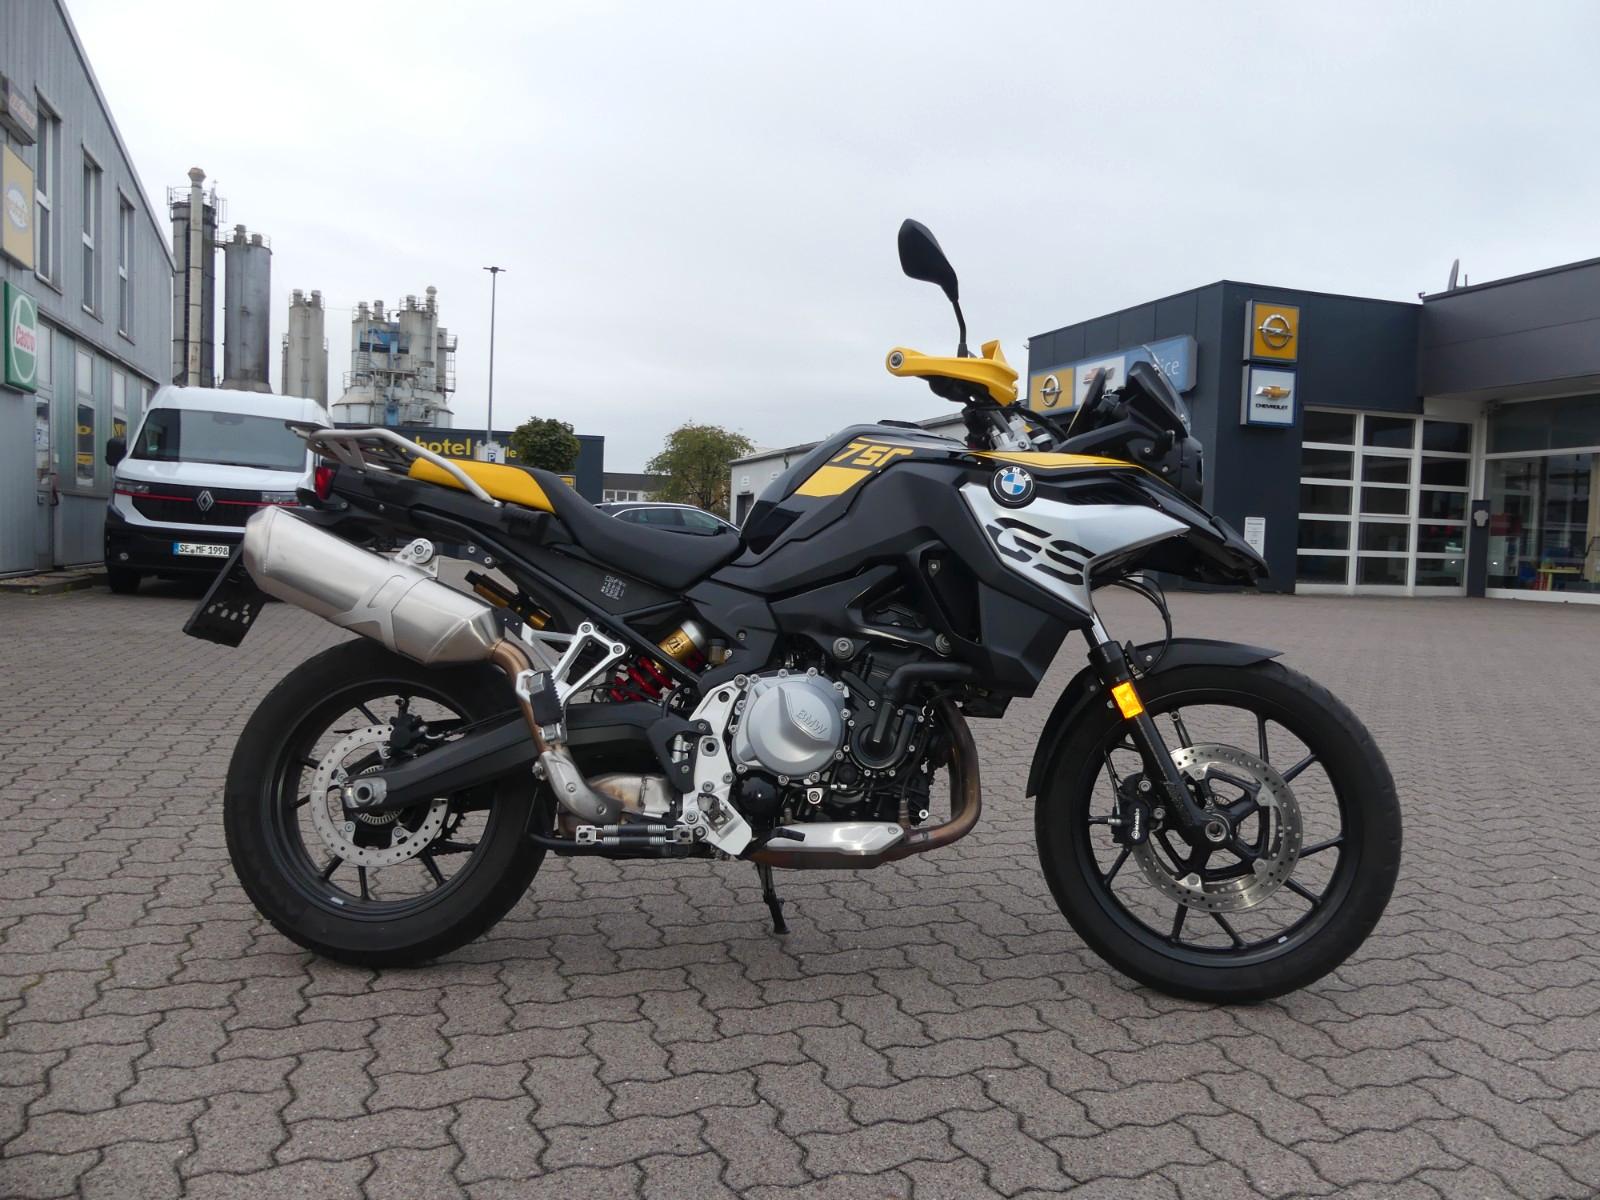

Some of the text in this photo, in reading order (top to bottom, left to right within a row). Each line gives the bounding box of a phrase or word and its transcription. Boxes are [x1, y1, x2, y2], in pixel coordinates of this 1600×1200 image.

[414, 436, 471, 456] hotel
[1000, 466, 1031, 482] BMW
[179, 544, 190, 553] SE
[208, 546, 228, 556] 1998
[985, 517, 1097, 586] GS
[797, 709, 828, 735] BMW
